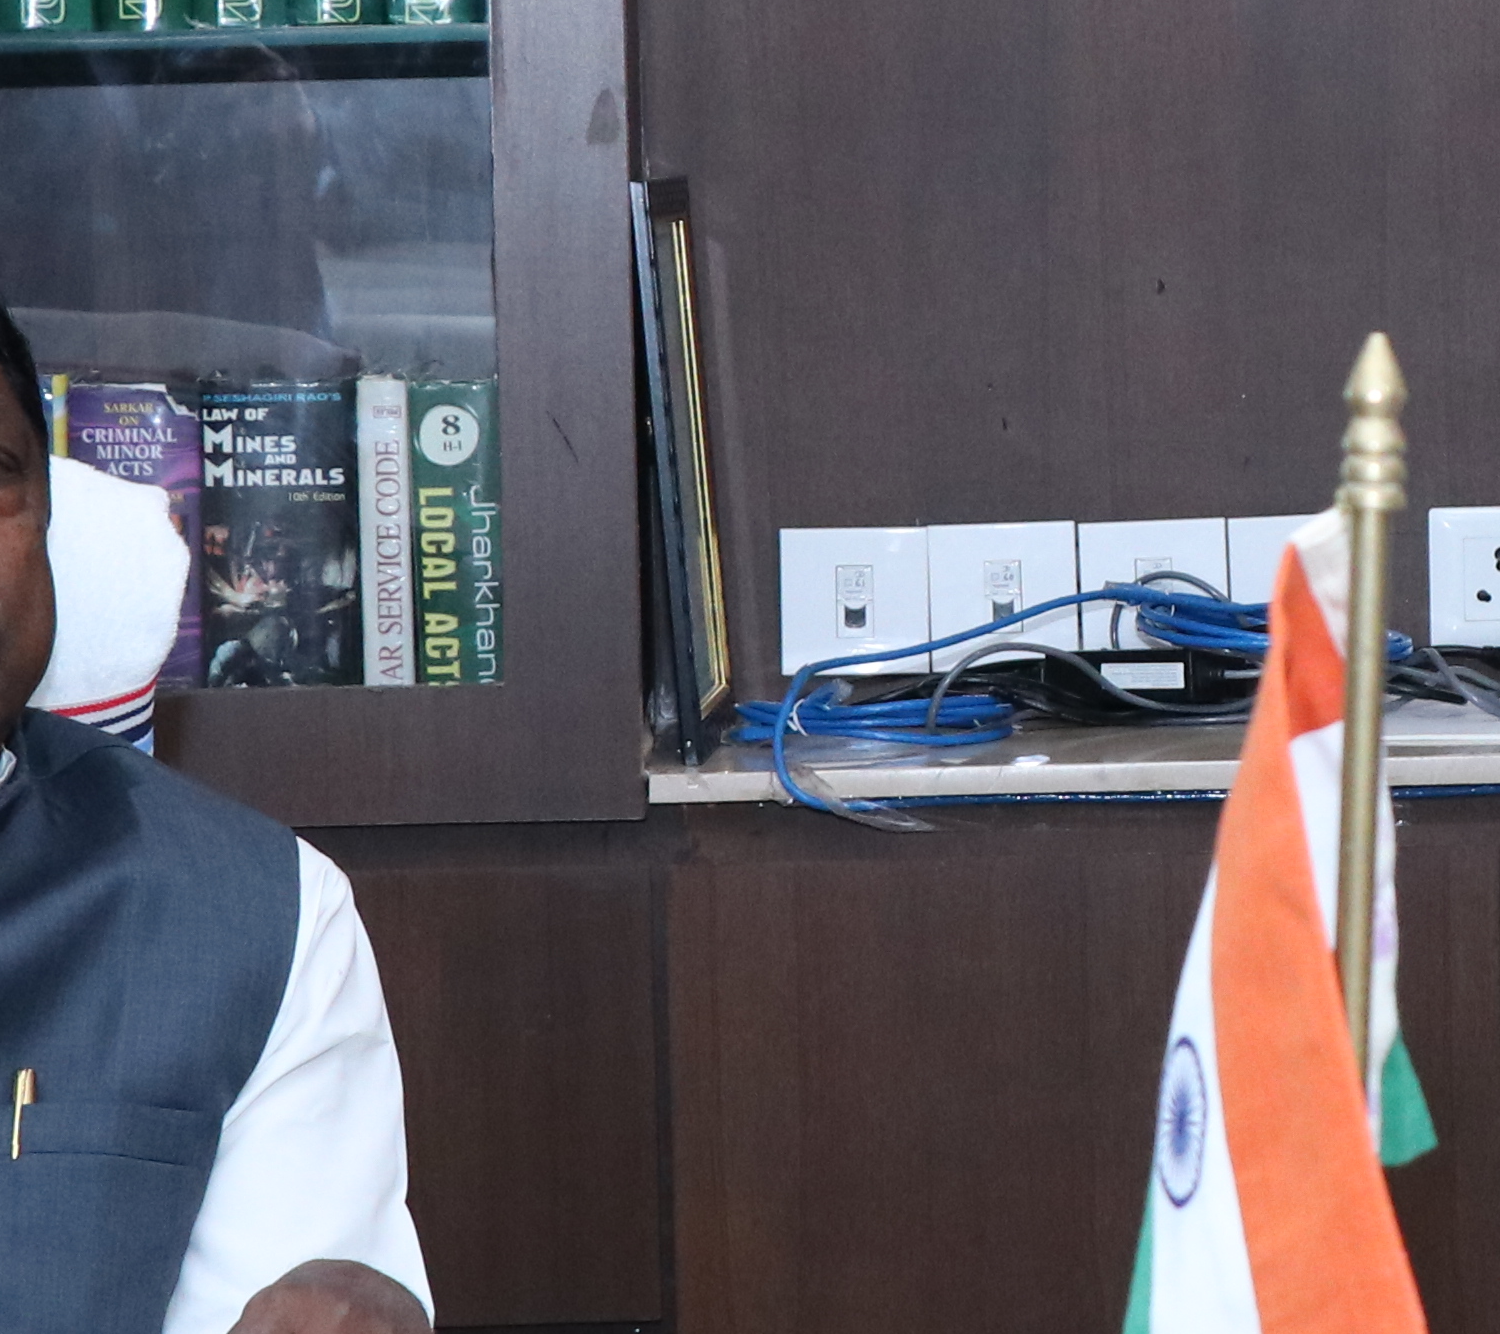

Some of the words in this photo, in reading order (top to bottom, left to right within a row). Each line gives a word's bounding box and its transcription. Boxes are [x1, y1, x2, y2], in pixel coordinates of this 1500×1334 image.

[295, 392, 341, 402] RAO'S
[103, 402, 154, 414] SARKAR
[203, 408, 238, 421] LAW
[244, 408, 269, 421] OF
[119, 415, 138, 426] ON
[441, 414, 461, 436] 8
[81, 428, 177, 444] CRIMINAL
[203, 423, 298, 454] MINES
[96, 444, 164, 460] MINOR
[264, 454, 296, 465] AND
[106, 461, 154, 477] ACTS
[204, 458, 346, 487] MINERALS
[374, 439, 401, 515] CODE
[288, 491, 309, 502] 10th
[312, 491, 346, 502] Edition
[418, 486, 457, 600] LOCAL
[376, 523, 404, 635] SERVICE
[470, 484, 501, 685] Jharkhan
[423, 612, 462, 686] ACT
